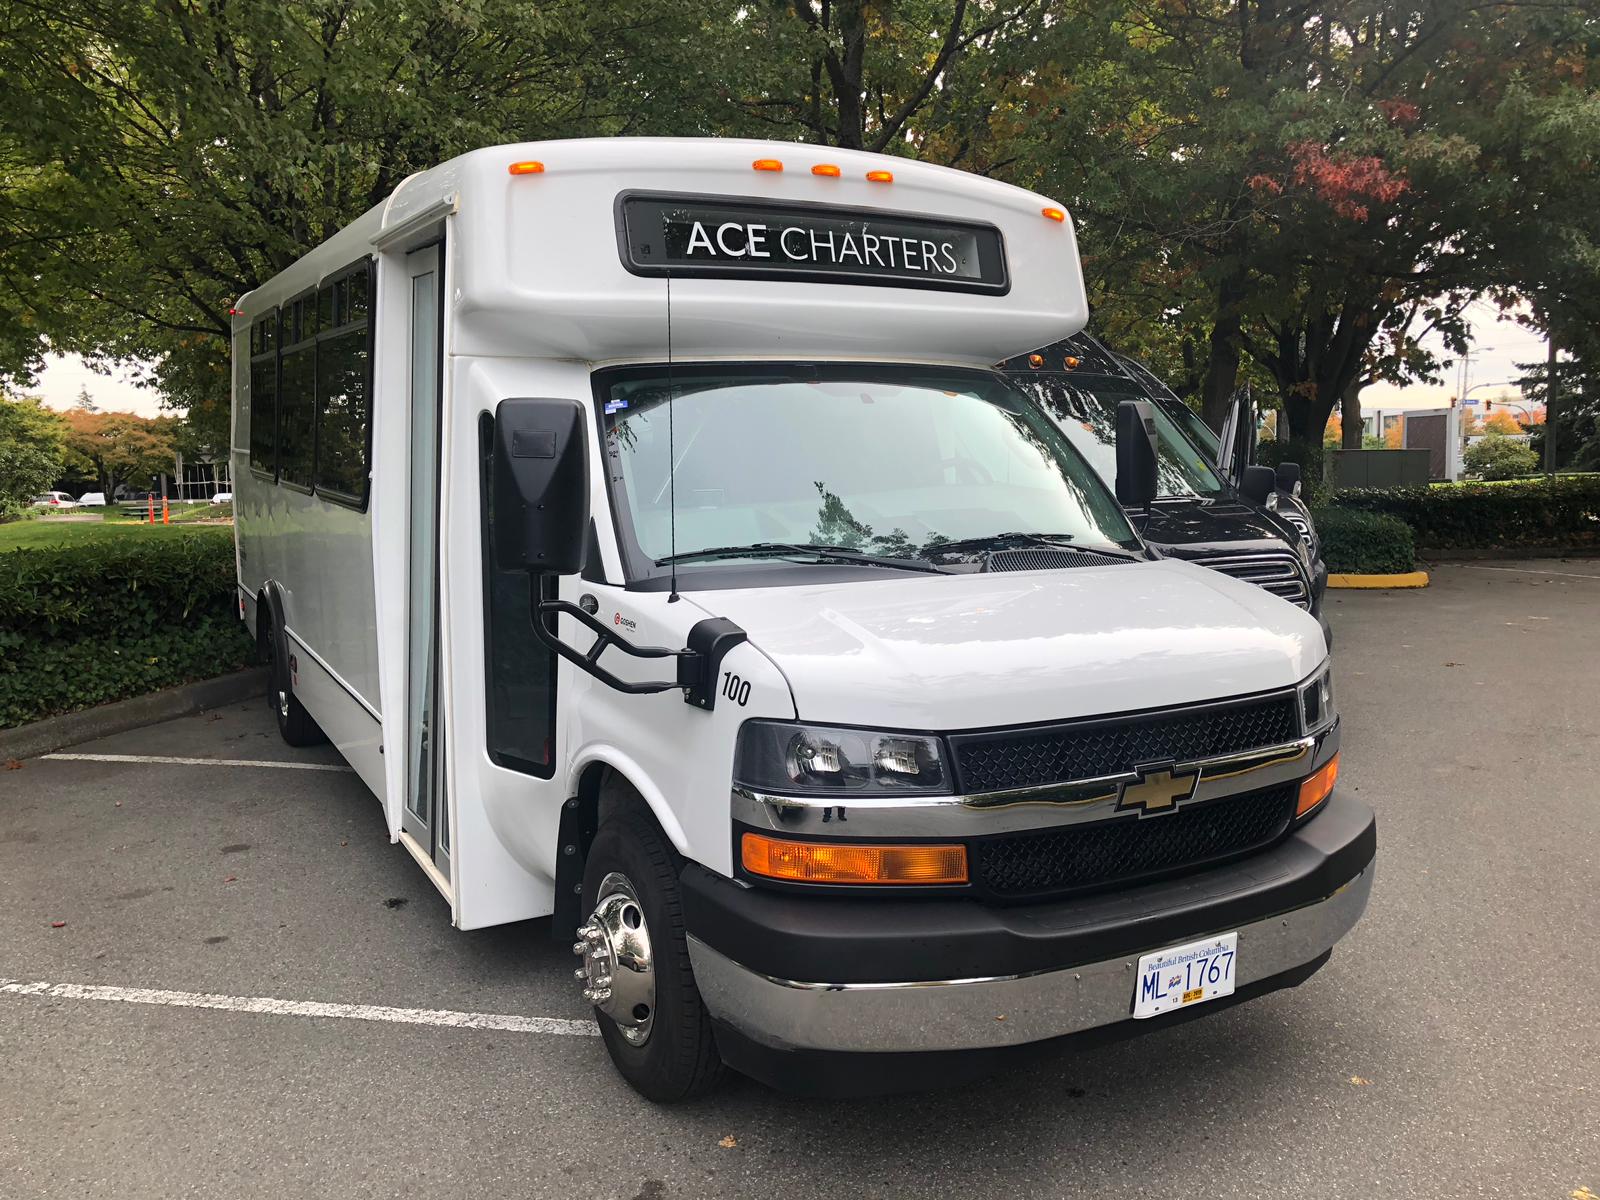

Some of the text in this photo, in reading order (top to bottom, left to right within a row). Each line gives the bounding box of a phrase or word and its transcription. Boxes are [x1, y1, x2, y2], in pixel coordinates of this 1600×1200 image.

[686, 221, 957, 274] ACE CHARTERS
[620, 617, 636, 629] GOSHEN
[722, 671, 751, 707] 100
[1148, 945, 1229, 972] Beautiful British Columbia
[1142, 951, 1234, 1003] ML 1767
